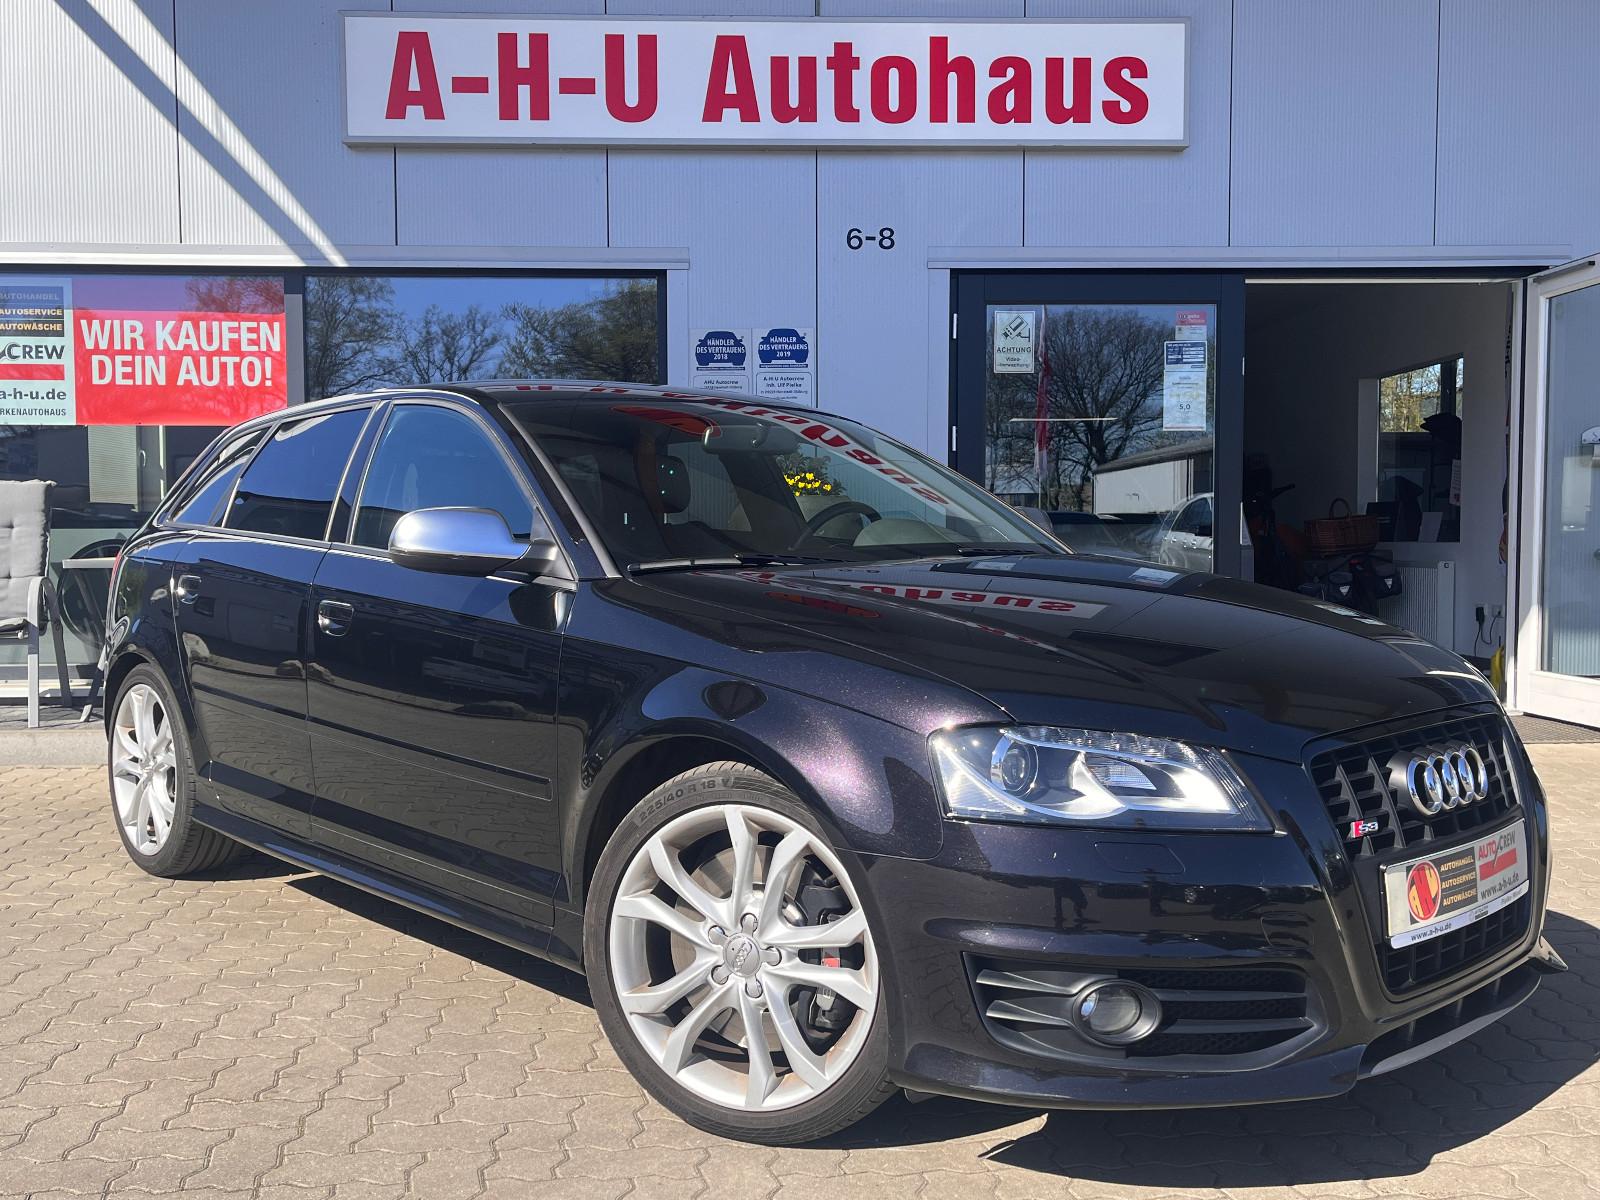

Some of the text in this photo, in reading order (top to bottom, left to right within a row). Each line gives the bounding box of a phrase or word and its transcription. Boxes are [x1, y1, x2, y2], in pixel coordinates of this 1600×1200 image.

[385, 32, 1149, 123] A-H-U Autohaus
[846, 227, 896, 250] 6-8
[80, 320, 281, 352] WIR KAUFEN
[707, 337, 735, 346] HÄNDLER
[769, 335, 797, 343] HÄNDLER
[696, 346, 746, 354] DES VERTRAUENS
[91, 355, 273, 387] DEIN AUTO!
[638, 787, 685, 821] 225/40
[700, 779, 716, 790] 18
[1358, 821, 1379, 832] S3
[1440, 855, 1474, 872] AUTOHANDEL
[1441, 871, 1476, 889] AUTOSERVICE
[1480, 870, 1520, 901] www.a-h-u.de
[1410, 922, 1452, 942] www.a-h-u.de
